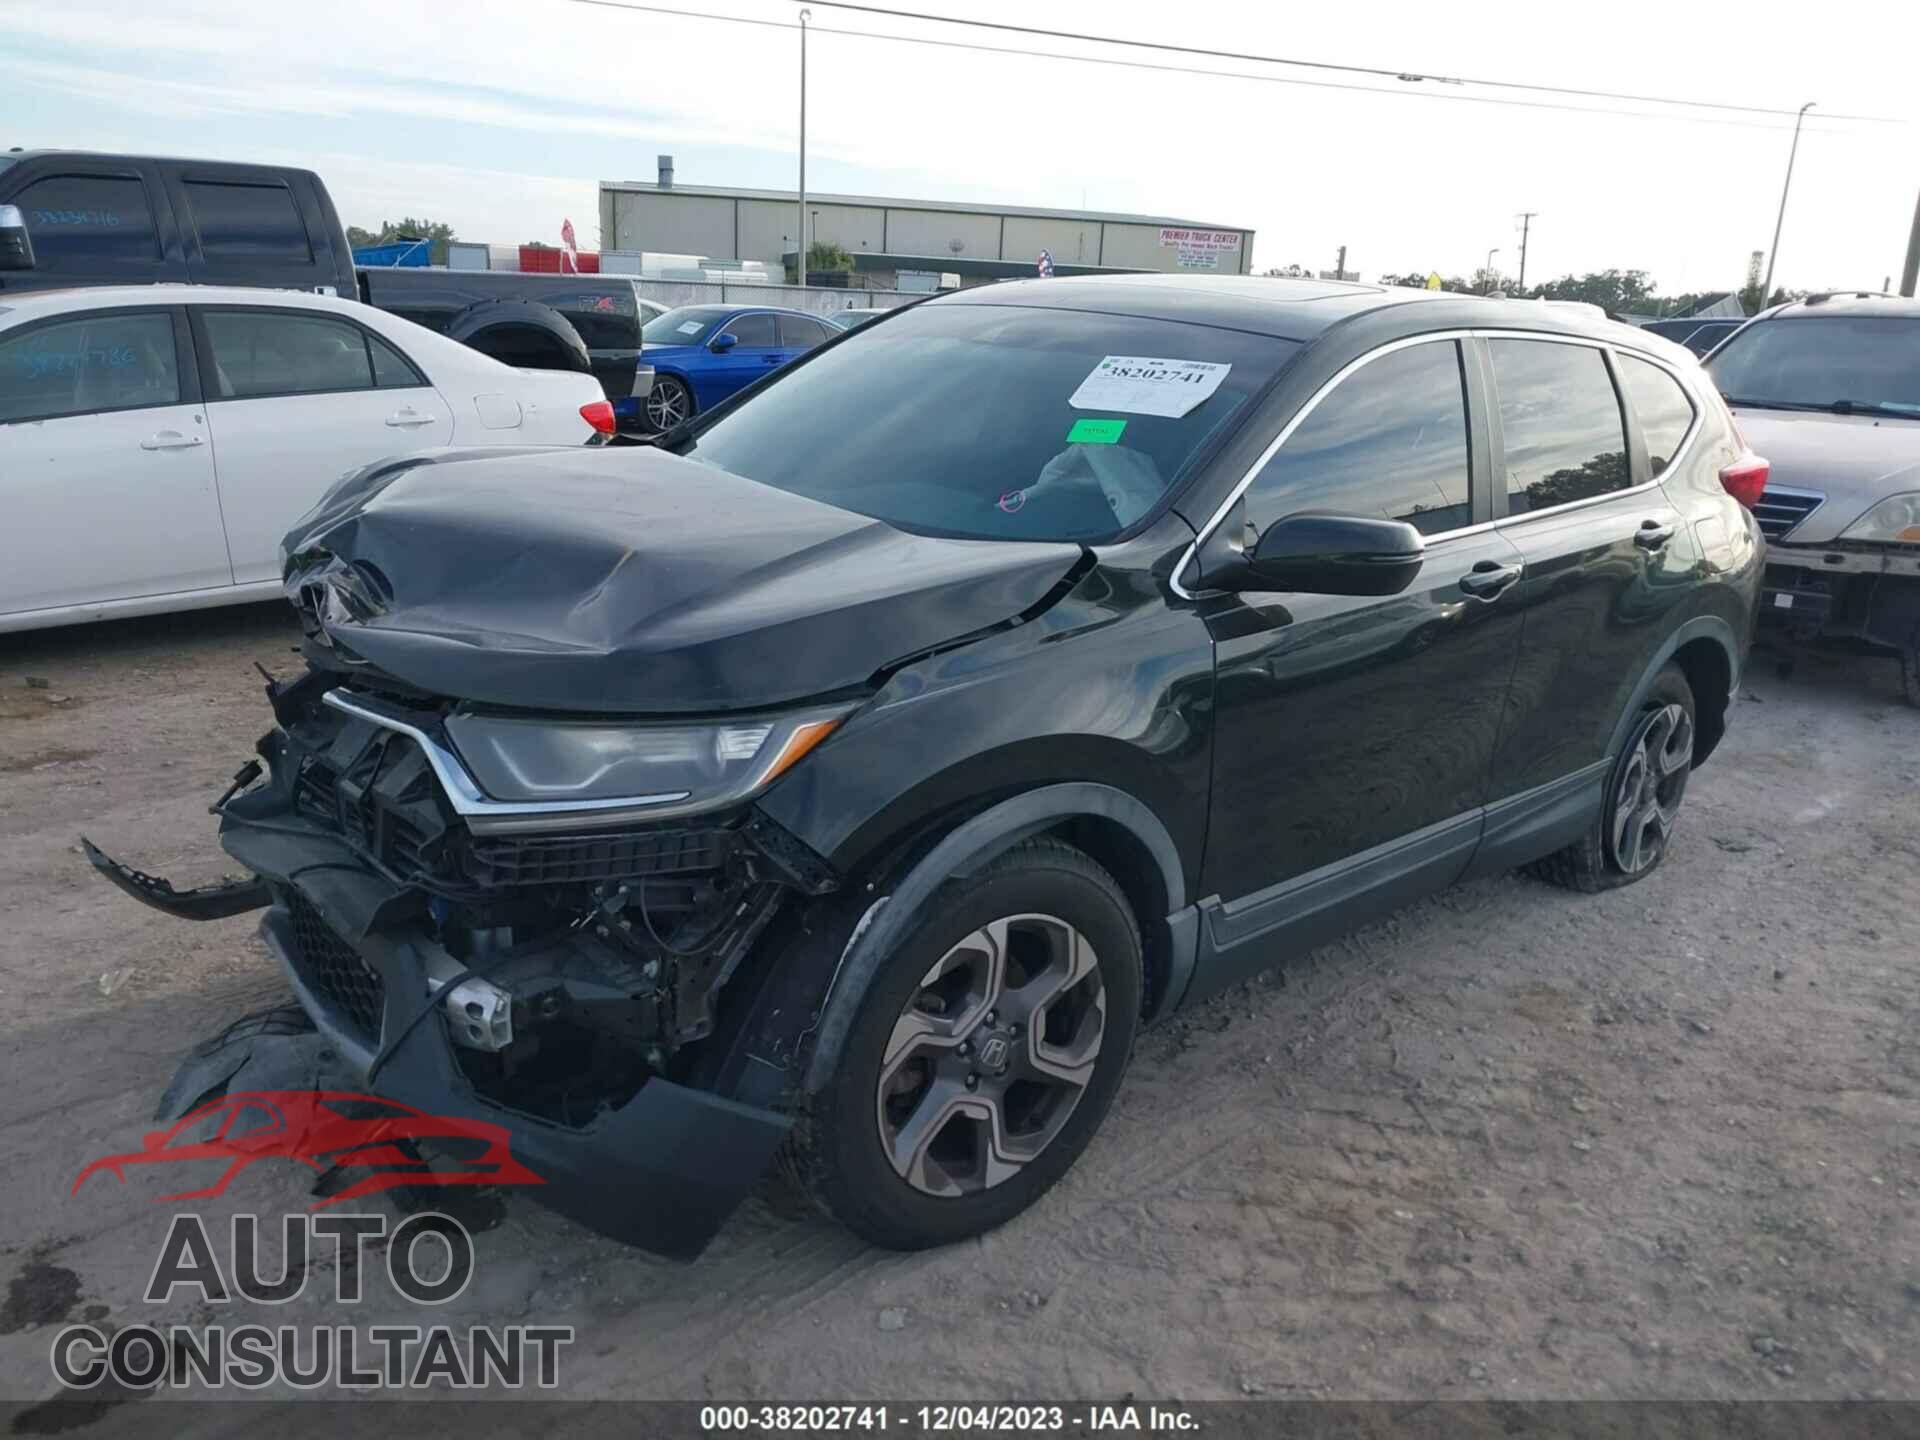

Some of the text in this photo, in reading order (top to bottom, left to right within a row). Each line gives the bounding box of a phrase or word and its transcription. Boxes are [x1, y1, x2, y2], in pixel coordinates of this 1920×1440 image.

[1161, 230, 1238, 244] PREMIER TRUCK CENTER
[1106, 366, 1206, 384] 38202741
